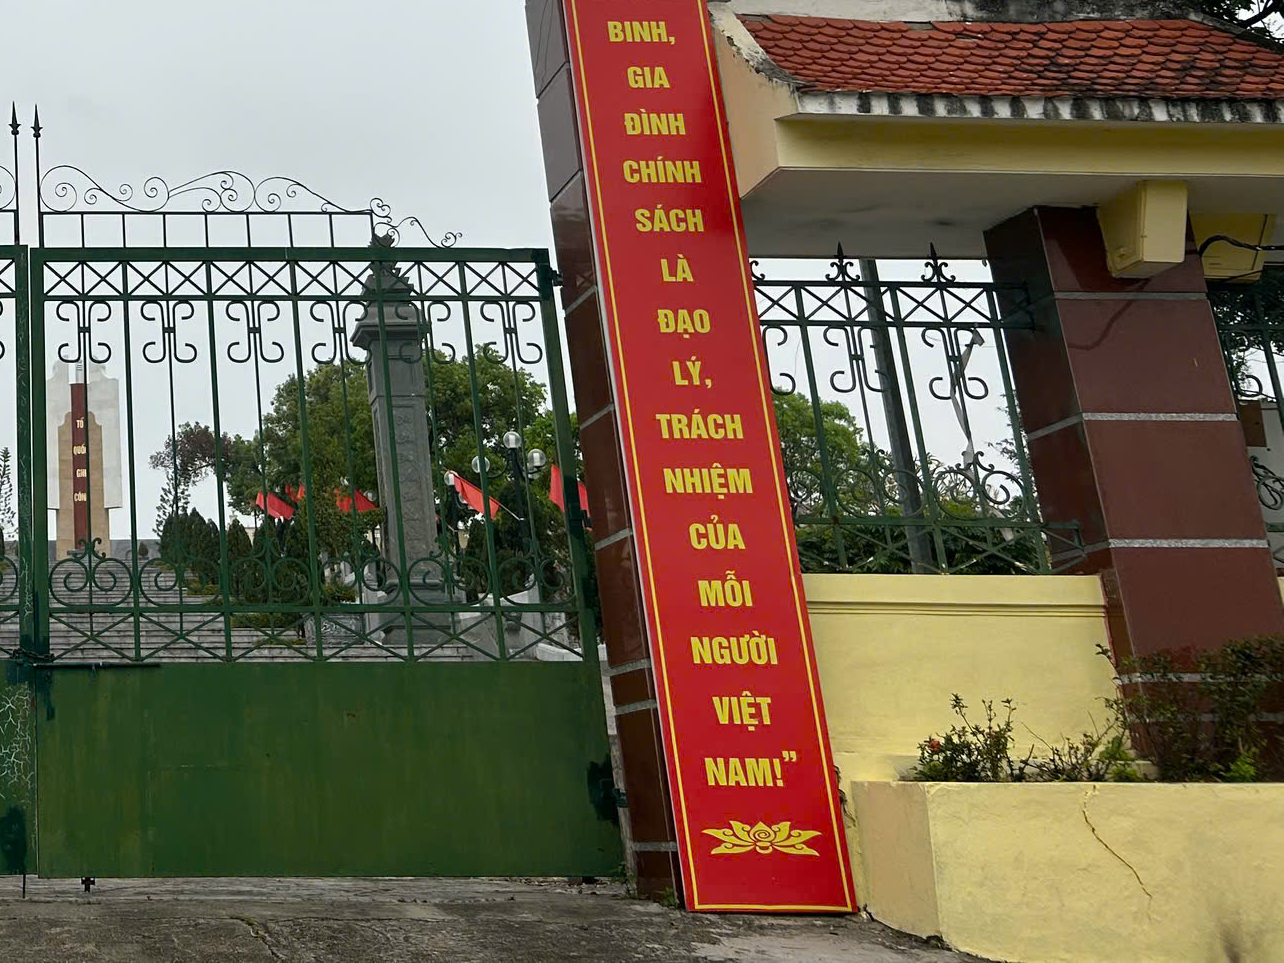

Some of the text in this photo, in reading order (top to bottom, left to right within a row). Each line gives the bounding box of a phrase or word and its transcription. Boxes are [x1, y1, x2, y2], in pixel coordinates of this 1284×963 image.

[607, 20, 676, 45] BINH,
[627, 66, 671, 89] GIA
[623, 108, 687, 136] ĐÌNH
[622, 155, 702, 184] CHÍNH
[634, 204, 705, 232] SÁCH
[660, 253, 694, 282] LÀ
[657, 308, 711, 339] ĐẠO
[671, 355, 712, 389] LÝ,
[655, 408, 744, 440] TRÁCH
[662, 462, 754, 500] NHIỆM
[74, 492, 87, 502] CÔN
[688, 514, 746, 550] CỦA
[697, 570, 753, 607] MỖI
[690, 630, 779, 665] NGƯỜI
[711, 690, 772, 732] VIỆT
